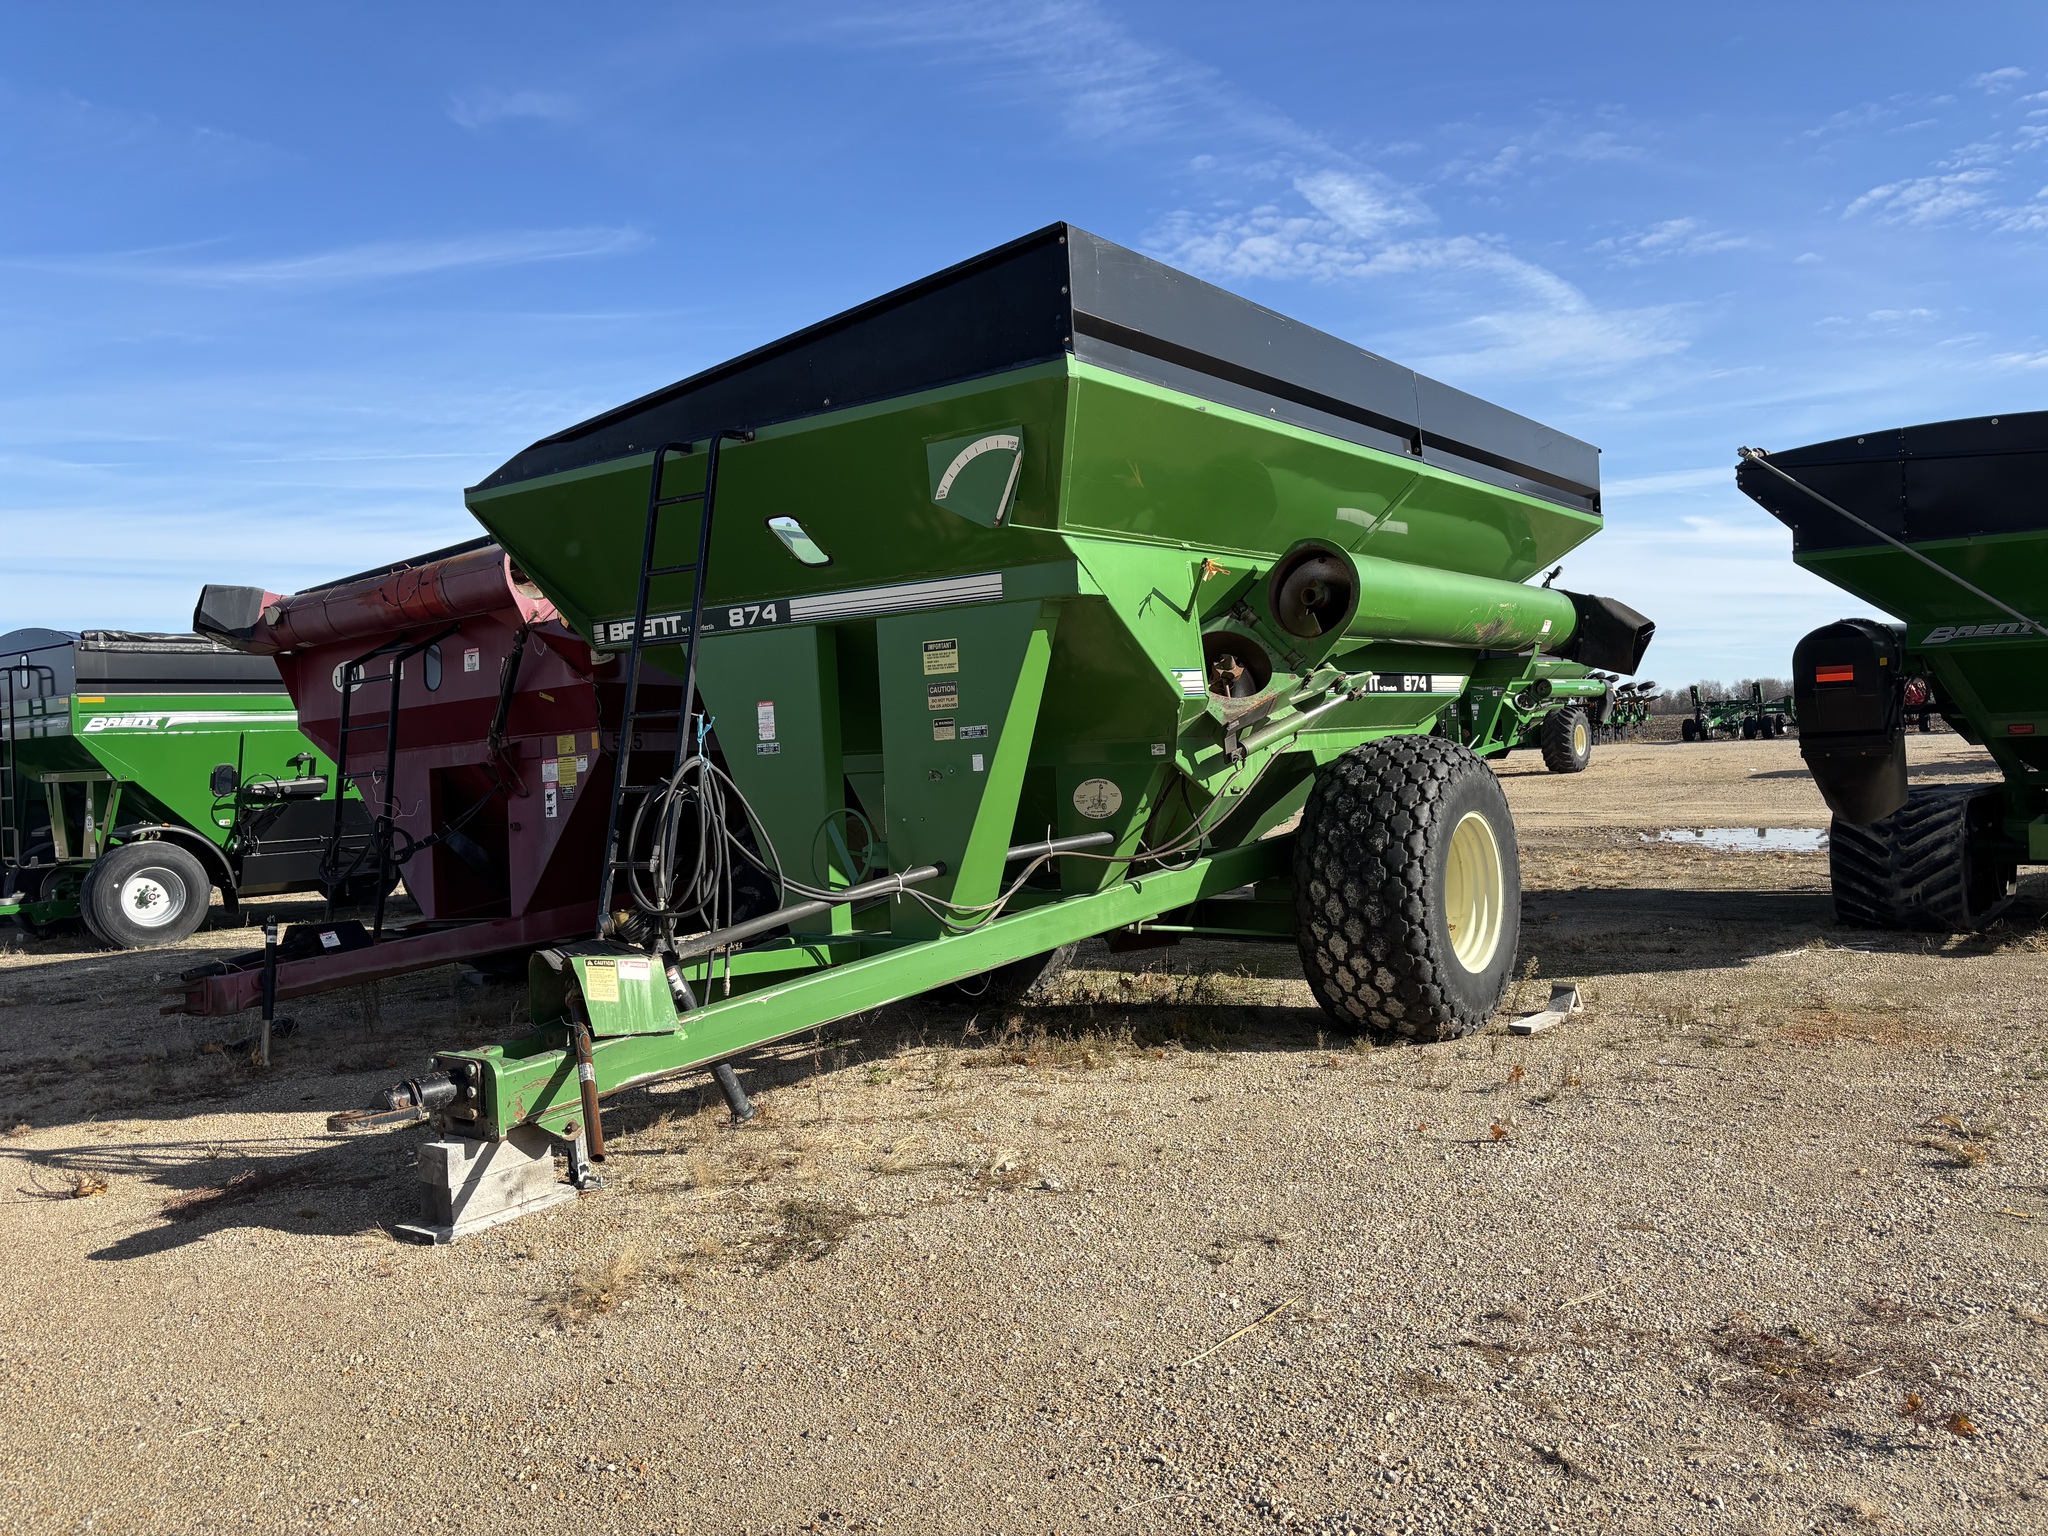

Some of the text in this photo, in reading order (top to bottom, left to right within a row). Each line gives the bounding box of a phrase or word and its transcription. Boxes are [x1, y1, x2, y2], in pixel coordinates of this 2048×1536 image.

[609, 615, 681, 641] BRENT
[728, 603, 777, 627] 874
[1921, 620, 2040, 644] BRENT
[927, 641, 952, 651] IMPORTANT
[929, 685, 956, 694] CAUTION
[1403, 675, 1427, 691] 874
[82, 717, 163, 732] BRENT
